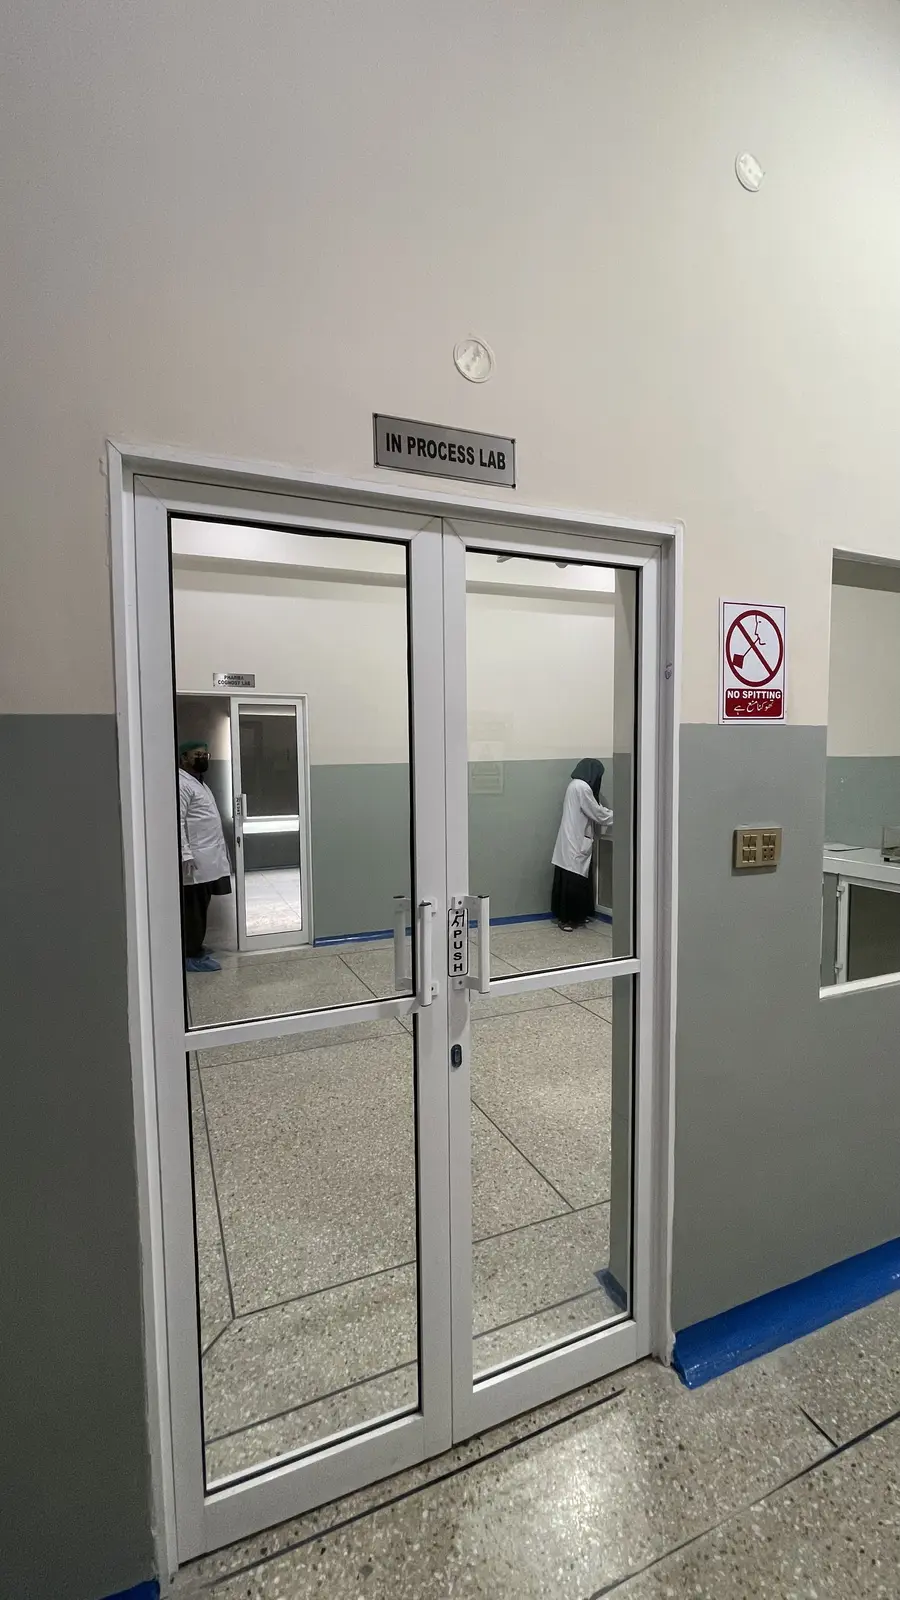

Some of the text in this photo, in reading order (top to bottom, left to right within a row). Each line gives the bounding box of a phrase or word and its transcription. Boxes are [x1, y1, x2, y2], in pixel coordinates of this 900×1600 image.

[385, 432, 506, 470] IN PROCESS LAB
[727, 690, 781, 699] NO SPITTING
[733, 705, 746, 716] ہے
[746, 700, 758, 713] منع
[453, 929, 463, 973] PUSH
